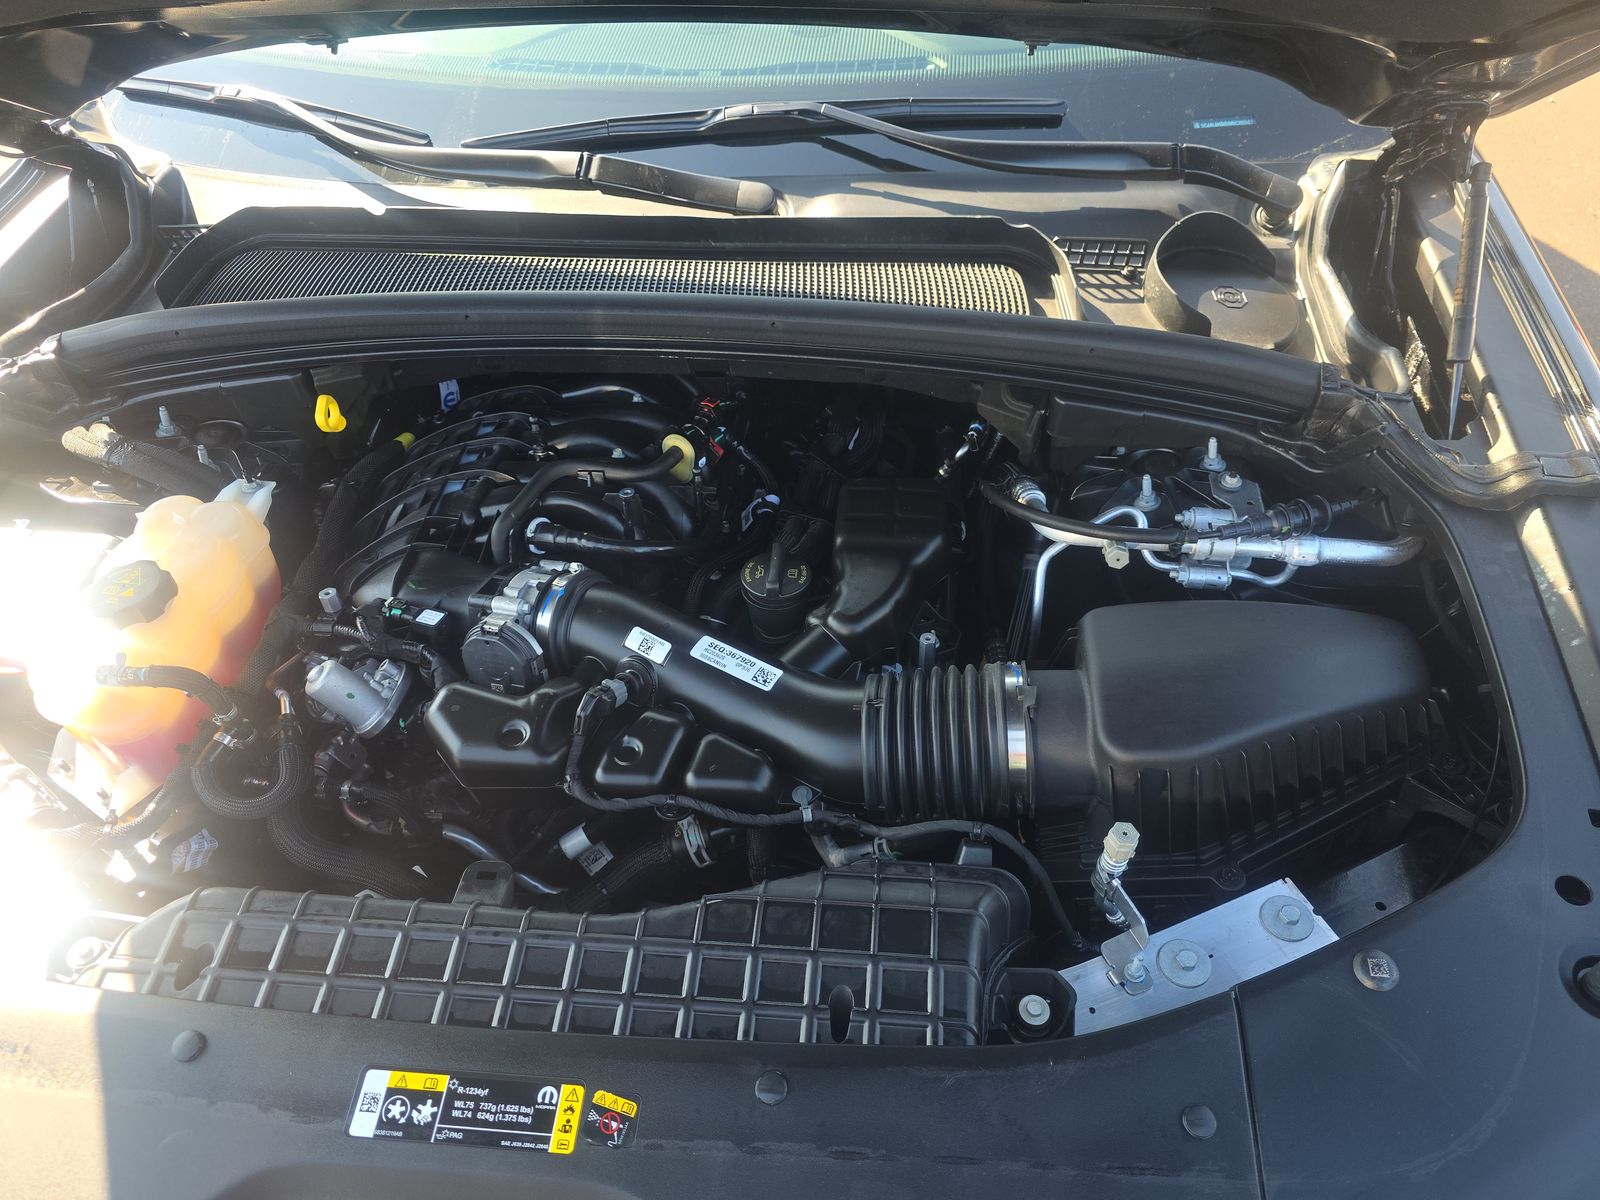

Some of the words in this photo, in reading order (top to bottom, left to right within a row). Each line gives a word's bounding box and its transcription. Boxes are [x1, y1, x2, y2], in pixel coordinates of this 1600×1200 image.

[708, 641, 757, 668] SEQ:367920
[457, 1086, 489, 1097] R-1234yf
[454, 1100, 475, 1109] WL75
[479, 1102, 497, 1113] 737g
[497, 1104, 519, 1114] (1.625
[520, 1105, 534, 1115] lbs)
[452, 1109, 472, 1118] WL74
[476, 1111, 494, 1122] 624g
[495, 1112, 517, 1122] (1.375
[518, 1115, 532, 1125] lbs)
[449, 1131, 463, 1139] PAG
